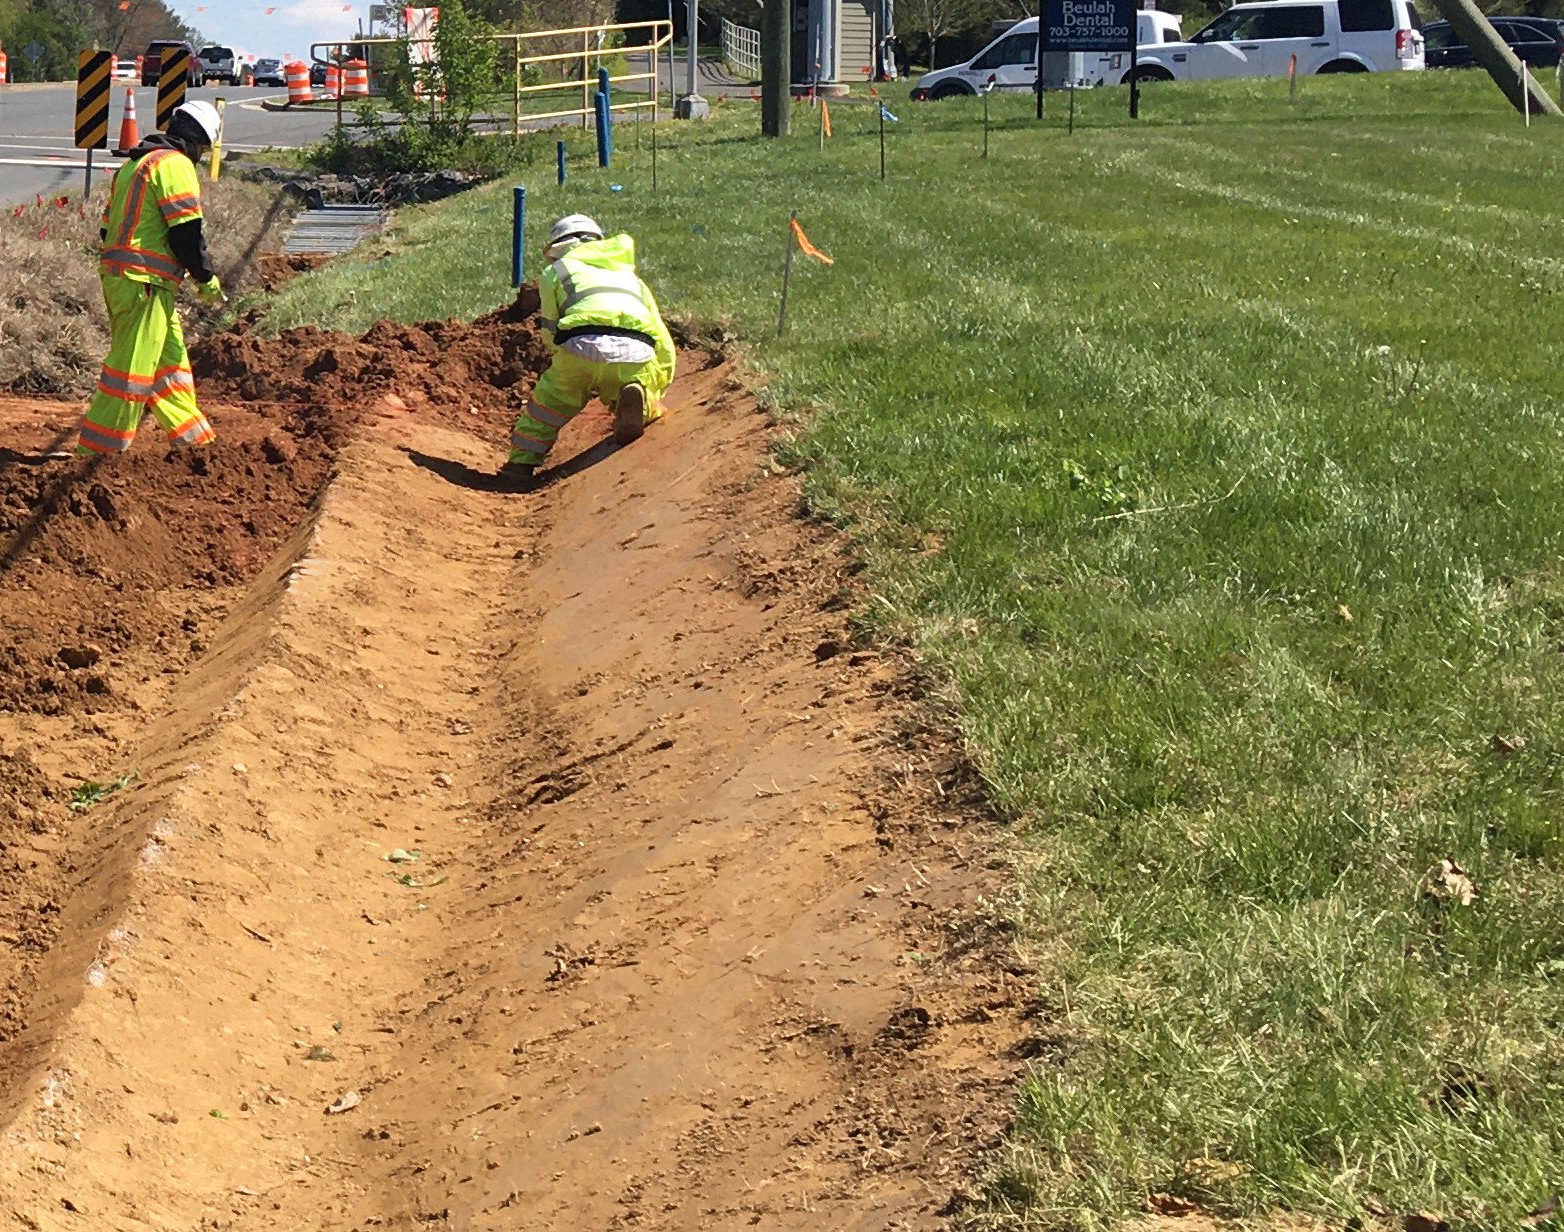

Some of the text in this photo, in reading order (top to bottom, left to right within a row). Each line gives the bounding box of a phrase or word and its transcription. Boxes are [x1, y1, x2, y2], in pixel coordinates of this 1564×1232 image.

[1062, 0, 1116, 14] Beulah
[1063, 13, 1114, 26] Dental
[1049, 26, 1129, 36] 703-757-1000
